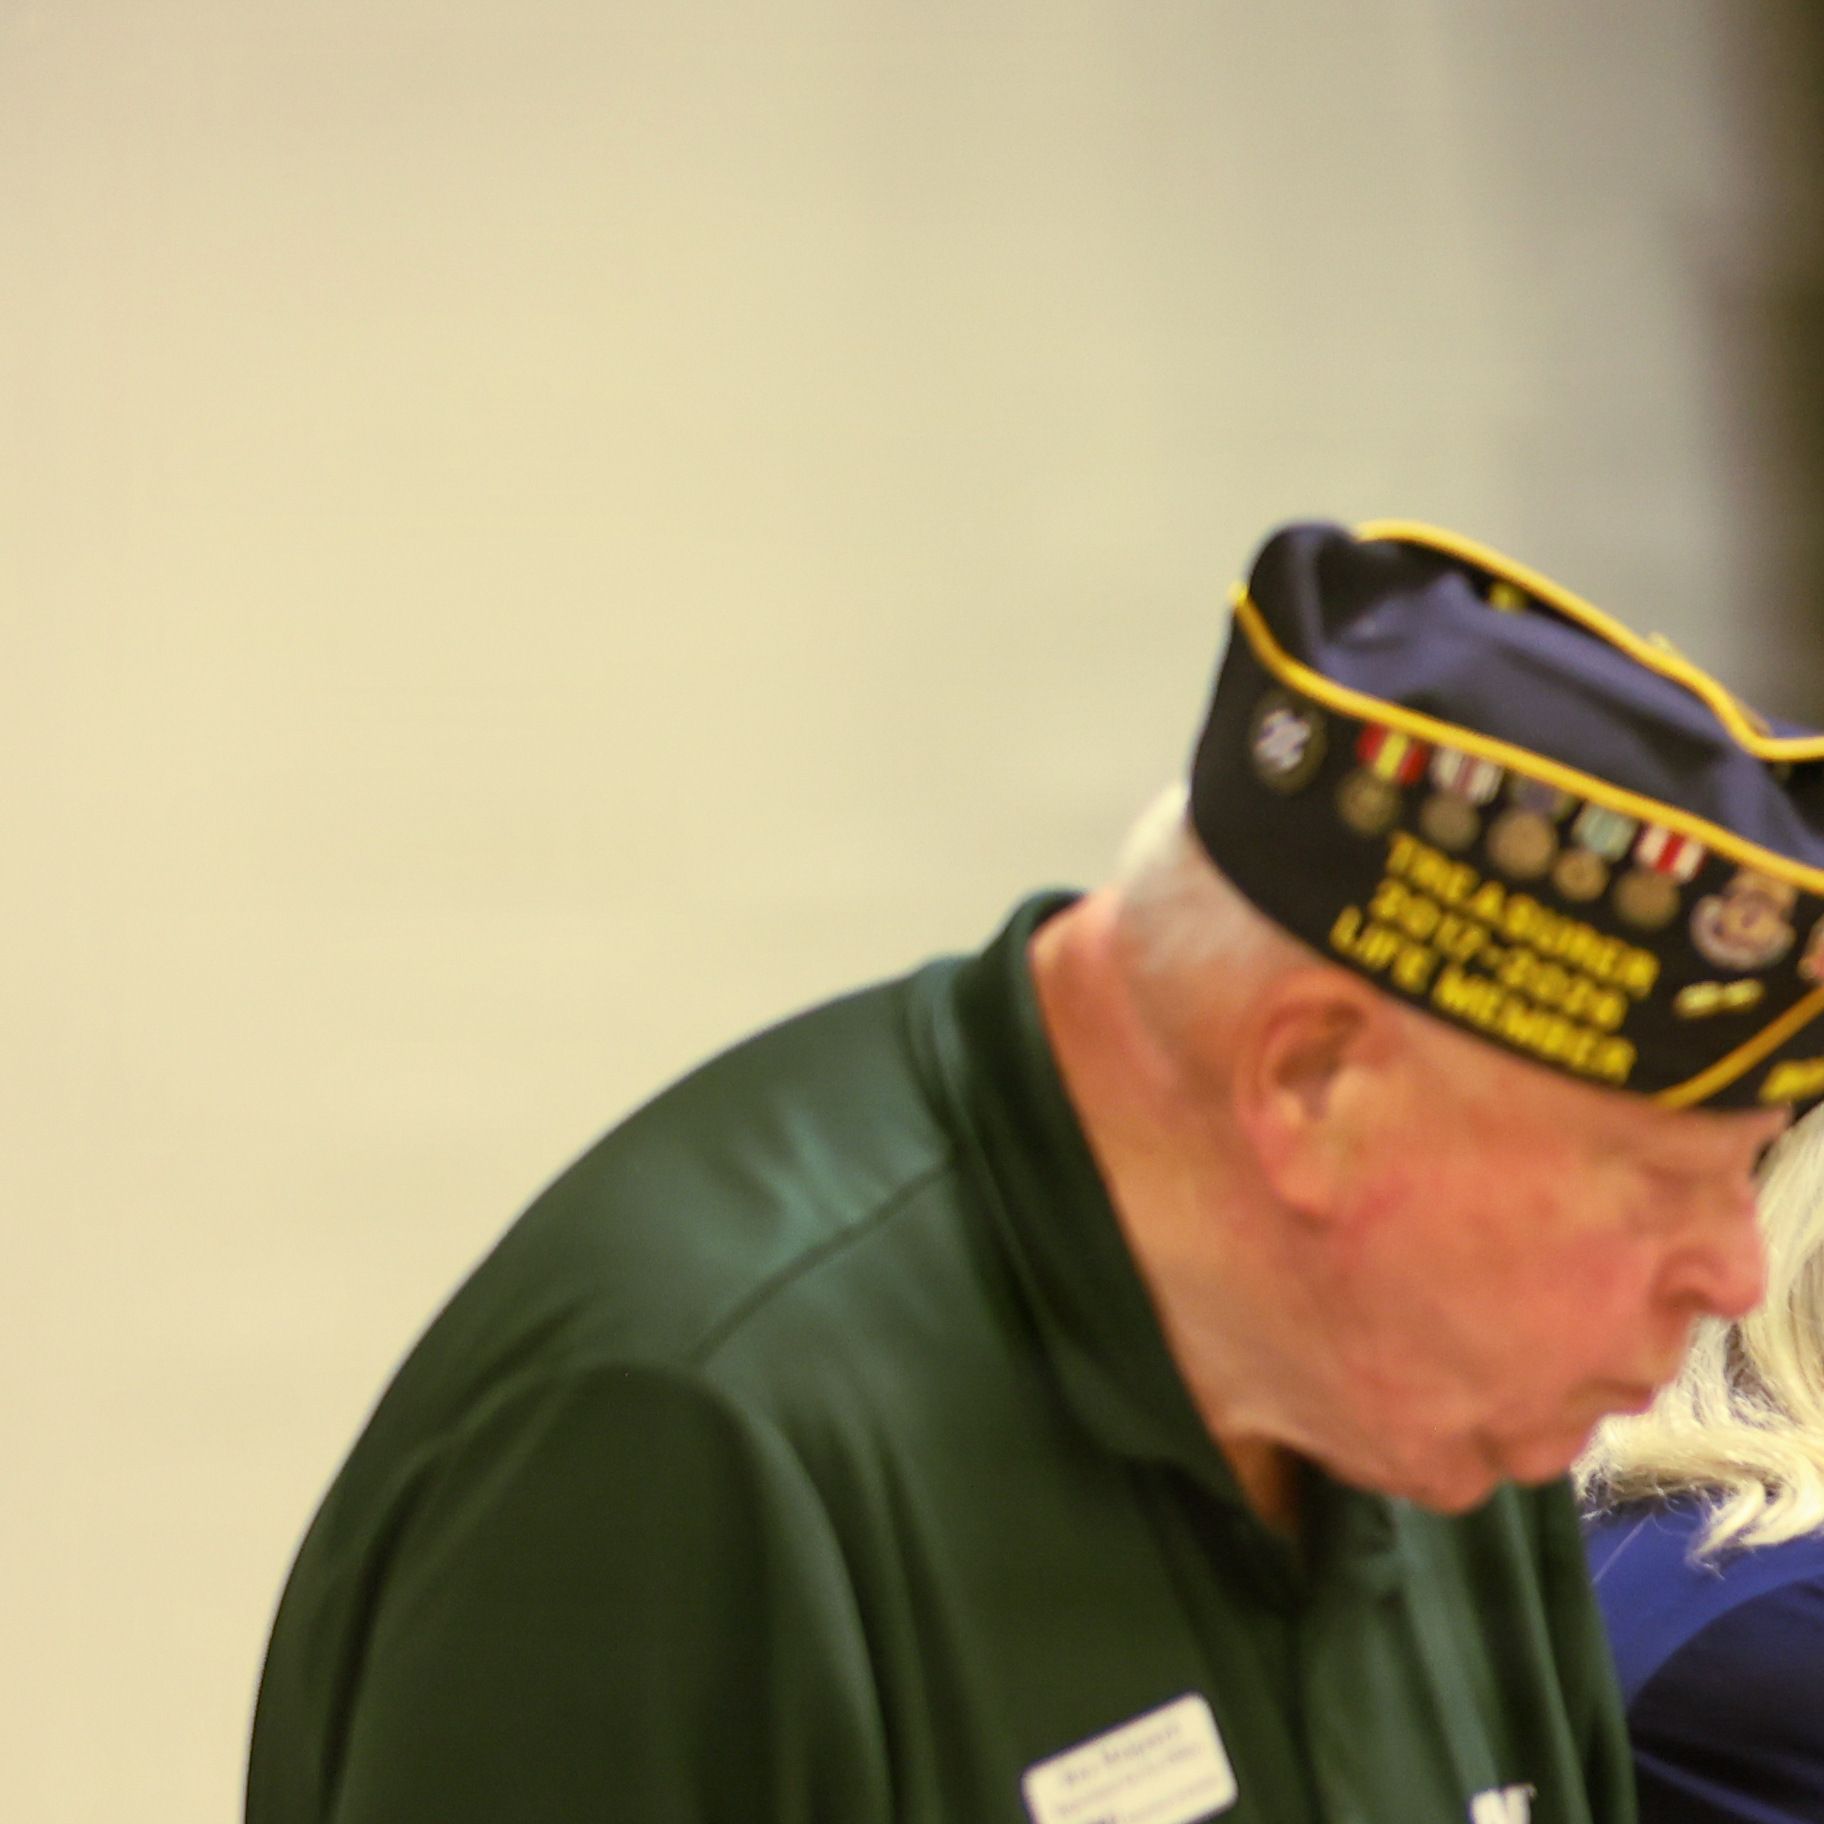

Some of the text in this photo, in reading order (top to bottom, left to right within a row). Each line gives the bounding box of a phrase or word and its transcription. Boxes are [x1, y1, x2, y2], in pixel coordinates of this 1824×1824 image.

[1328, 904, 1640, 1086] LIFE MEMBER
[1386, 831, 1662, 997] TREASURER
